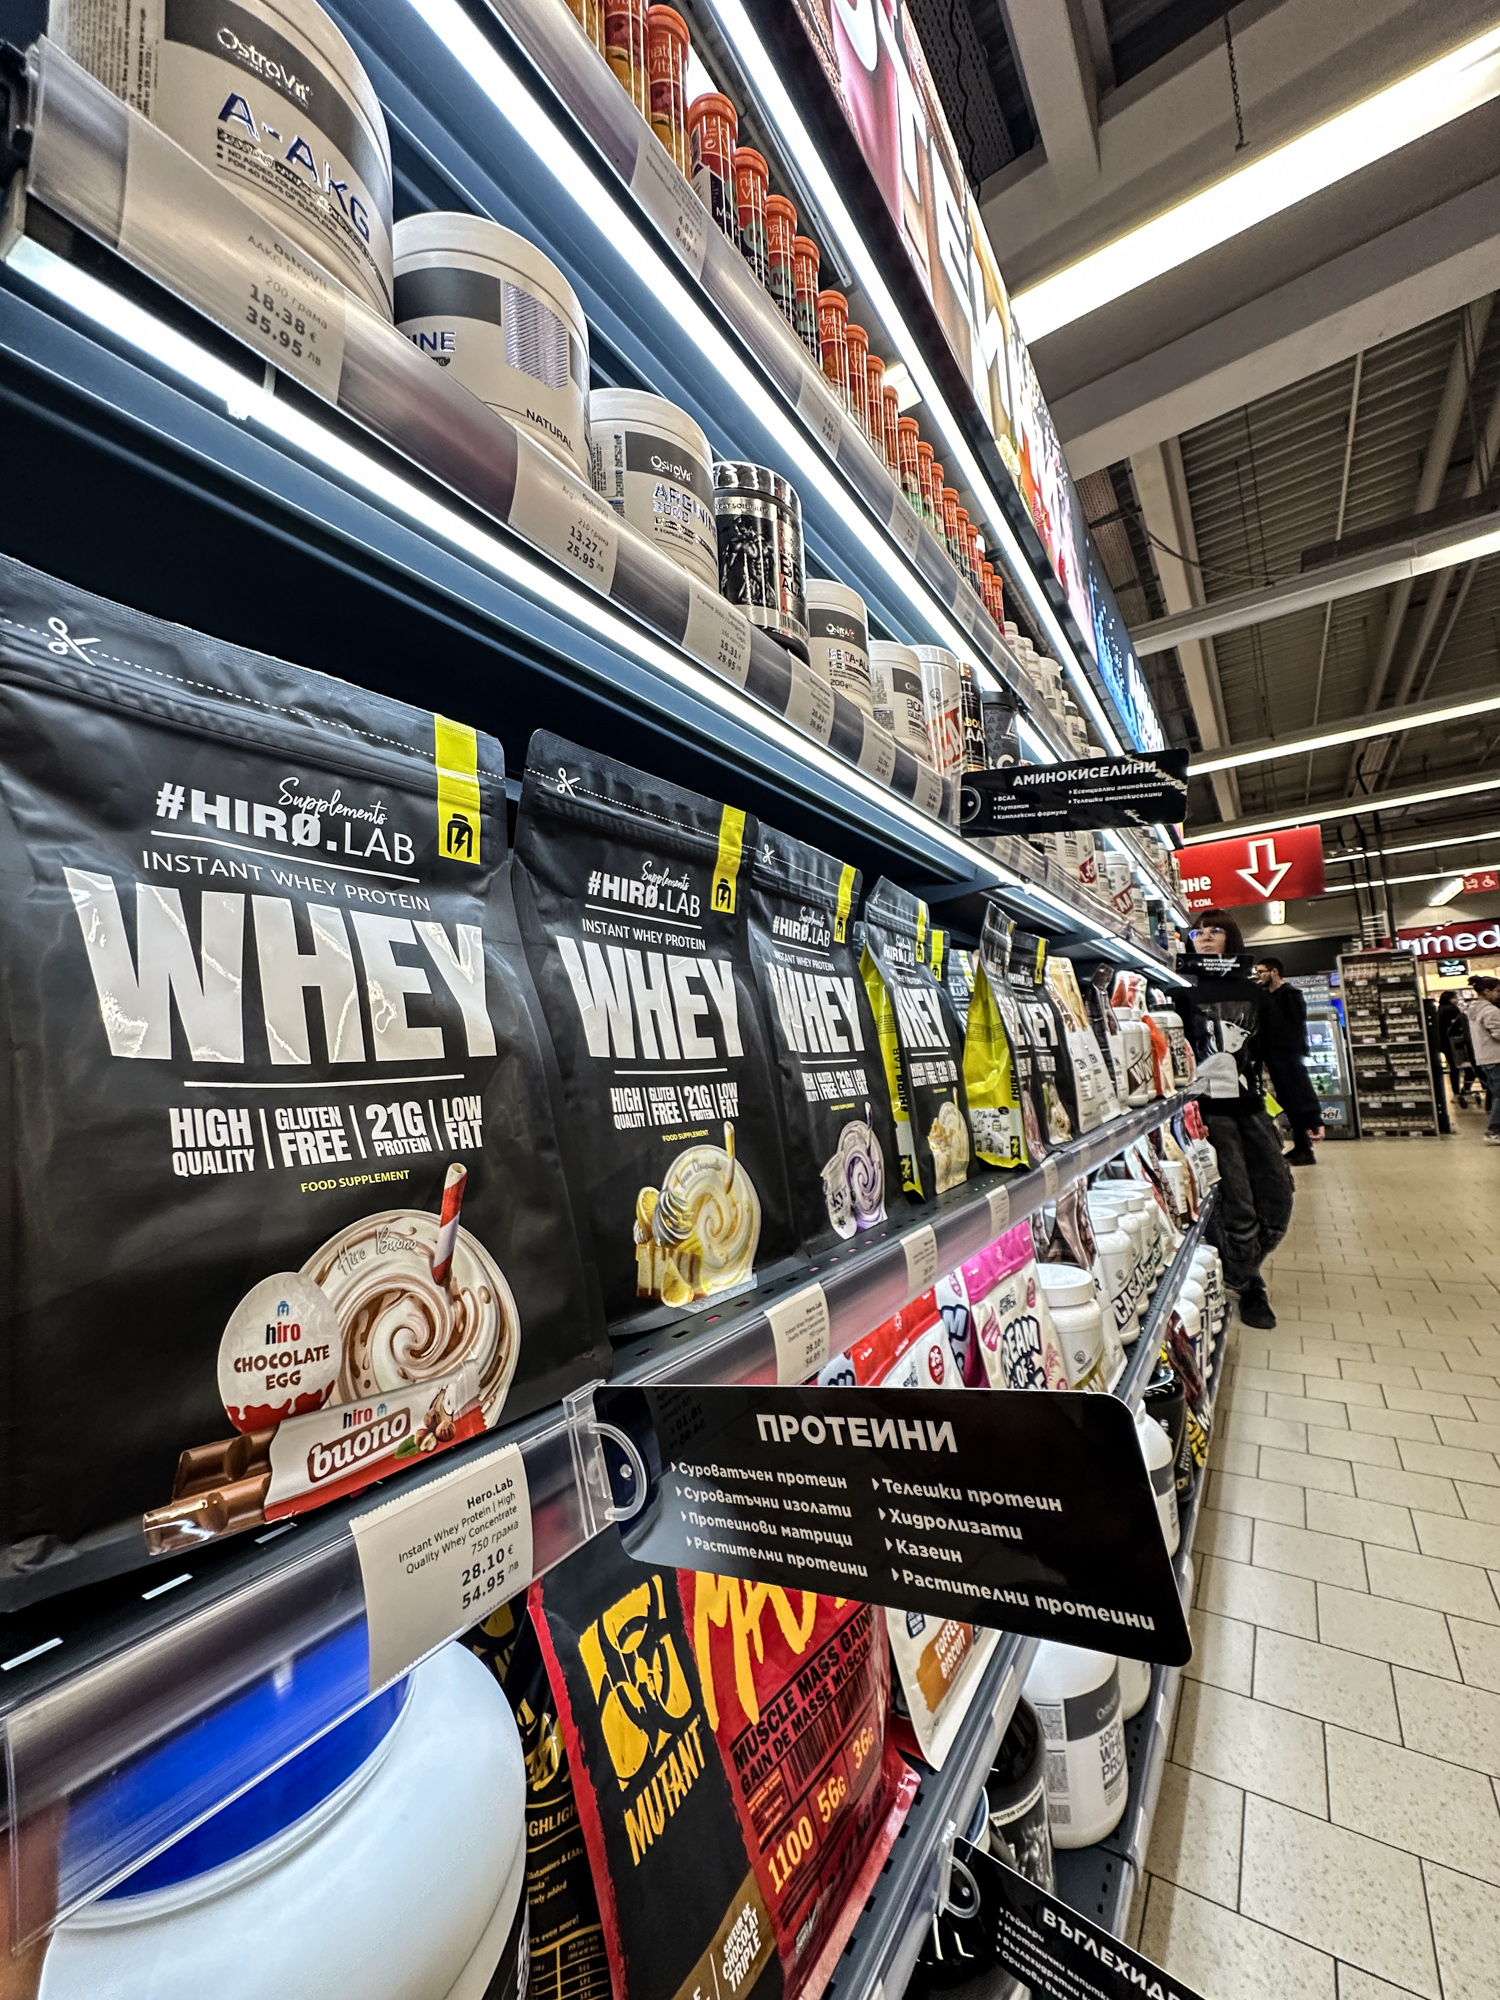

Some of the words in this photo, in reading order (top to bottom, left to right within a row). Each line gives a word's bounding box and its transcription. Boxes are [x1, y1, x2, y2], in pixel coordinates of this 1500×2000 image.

[217, 27, 311, 100] OstroVit
[218, 93, 369, 243] A-AKG
[228, 148, 240, 162] NO
[239, 153, 273, 178] ADDED
[228, 157, 245, 173] FOR
[261, 174, 283, 196] DAYS
[248, 235, 282, 267] AAKG
[274, 243, 328, 290] OstroVit
[251, 284, 305, 336] 18.38
[310, 331, 317, 343] €
[265, 276, 288, 298] 200
[292, 298, 328, 330] грама
[246, 306, 302, 358] 35.95
[308, 351, 322, 366] лв
[526, 409, 574, 452] NATURAL
[570, 526, 598, 553] 13.27
[578, 518, 590, 531] 210
[591, 529, 609, 546] грама
[567, 541, 595, 568] 25.95
[718, 652, 736, 670] 29.95
[720, 639, 737, 659] 15.31
[831, 679, 844, 687] 200
[1013, 761, 1157, 787] АМИНОКИСЕЛИНИ
[1073, 785, 1115, 795] Есенциални
[278, 777, 387, 825] Supplements
[997, 803, 1029, 811] Глутамин
[997, 812, 1036, 820] Комплексни
[1037, 808, 1067, 818] формули
[1073, 796, 1103, 805] Телешки
[1104, 791, 1162, 802] аминокиселини
[143, 850, 263, 881] INSTANT
[271, 868, 336, 896] WHEY
[344, 884, 431, 912] PROTEIN
[641, 860, 691, 891] Supplements
[582, 918, 630, 939] INSTANT
[632, 927, 663, 945] WHEY
[665, 932, 706, 951] PROTEIN
[62, 866, 497, 1065] WHEY
[796, 956, 812, 968] WHEY
[812, 960, 835, 972] PROTEIN
[555, 934, 744, 1060] WHEY
[765, 961, 865, 1053] WHEY
[610, 1087, 643, 1113] HIGH
[648, 1086, 676, 1102] GLUTEN
[684, 1084, 712, 1110] 21G
[716, 1082, 738, 1100] LOW
[820, 1082, 839, 1099] FREE
[169, 1107, 252, 1149] HIGH
[275, 1106, 343, 1131] GLUTEN
[366, 1101, 427, 1140] 21G
[441, 1095, 482, 1123] LOW
[613, 1112, 645, 1130] QUALITY
[651, 1101, 682, 1125] FREE
[689, 1108, 715, 1121] PROTEIN
[720, 1098, 739, 1118] FAT
[172, 1149, 255, 1178] QUALITY
[279, 1128, 352, 1168] FREE
[373, 1136, 432, 1157] PROTEIN
[445, 1120, 483, 1150] FAT
[678, 1129, 709, 1140] SUPPLEMENT
[301, 1178, 337, 1193] FOOD
[339, 1169, 410, 1188] SUPPLEMENT
[374, 1225, 418, 1255] Buono
[266, 1322, 301, 1345] hiro
[234, 1344, 330, 1373] CHOCOLATE
[266, 1370, 301, 1390] EGG
[343, 1406, 373, 1429] hiro
[756, 1413, 957, 1454] ПРОТЕИНИ
[311, 1412, 408, 1478] buono
[467, 1478, 514, 1509] Hero.Lab
[679, 1462, 774, 1483] Суроватъчен
[776, 1471, 847, 1489] протеин
[684, 1487, 779, 1510] Суроватъчни
[783, 1498, 852, 1518] изолати
[882, 1478, 962, 1501] Телешки
[967, 1487, 1062, 1512] протеин
[398, 1537, 432, 1563] Instant
[434, 1523, 460, 1543] Whey
[462, 1506, 491, 1528] Protein
[497, 1491, 516, 1508] High
[406, 1548, 439, 1574] Quality
[441, 1533, 467, 1555] Whey
[468, 1505, 517, 1538] Concentrate
[471, 1537, 489, 1556] 750
[491, 1520, 519, 1545] грама
[689, 1511, 777, 1536] Протеинови
[781, 1524, 853, 1547] матрици
[889, 1508, 1023, 1540] Хидролизати
[461, 1547, 505, 1587] 28.10
[508, 1544, 514, 1555] €
[694, 1536, 782, 1567] Растителни
[787, 1555, 868, 1578] протеини
[896, 1538, 963, 1563] Казеин
[462, 1570, 505, 1610] 54.95
[508, 1561, 519, 1574] лв
[902, 1569, 1030, 1607] Растителни
[1035, 1594, 1156, 1631] протеини
[941, 1628, 966, 1680] BISCUIT
[732, 1689, 798, 1775] MUSCLE
[799, 1644, 840, 1703] MASS
[741, 1752, 773, 1796] GAIN
[775, 1731, 791, 1758] DE
[792, 1686, 832, 1738] MASSE
[852, 1726, 875, 1770] 36G
[624, 1717, 706, 1866] MUTANT
[817, 1775, 847, 1824] 56G
[768, 1816, 814, 1894] 1100
[547, 1880, 567, 1899] added
[541, 1927, 558, 1939] even
[559, 1914, 579, 1933] more!
[722, 1908, 760, 1980] CHOCOLAT
[723, 1916, 745, 1957] SAVEUR
[742, 1902, 751, 1920] DE
[1005, 1911, 1044, 1943] Гейнъри
[728, 1929, 761, 1992] TRIPLE
[1004, 1923, 1066, 1973] Изотонични
[1002, 1951, 1043, 1986] Оризови
[1003, 1936, 1080, 1998] Въглехидратни
